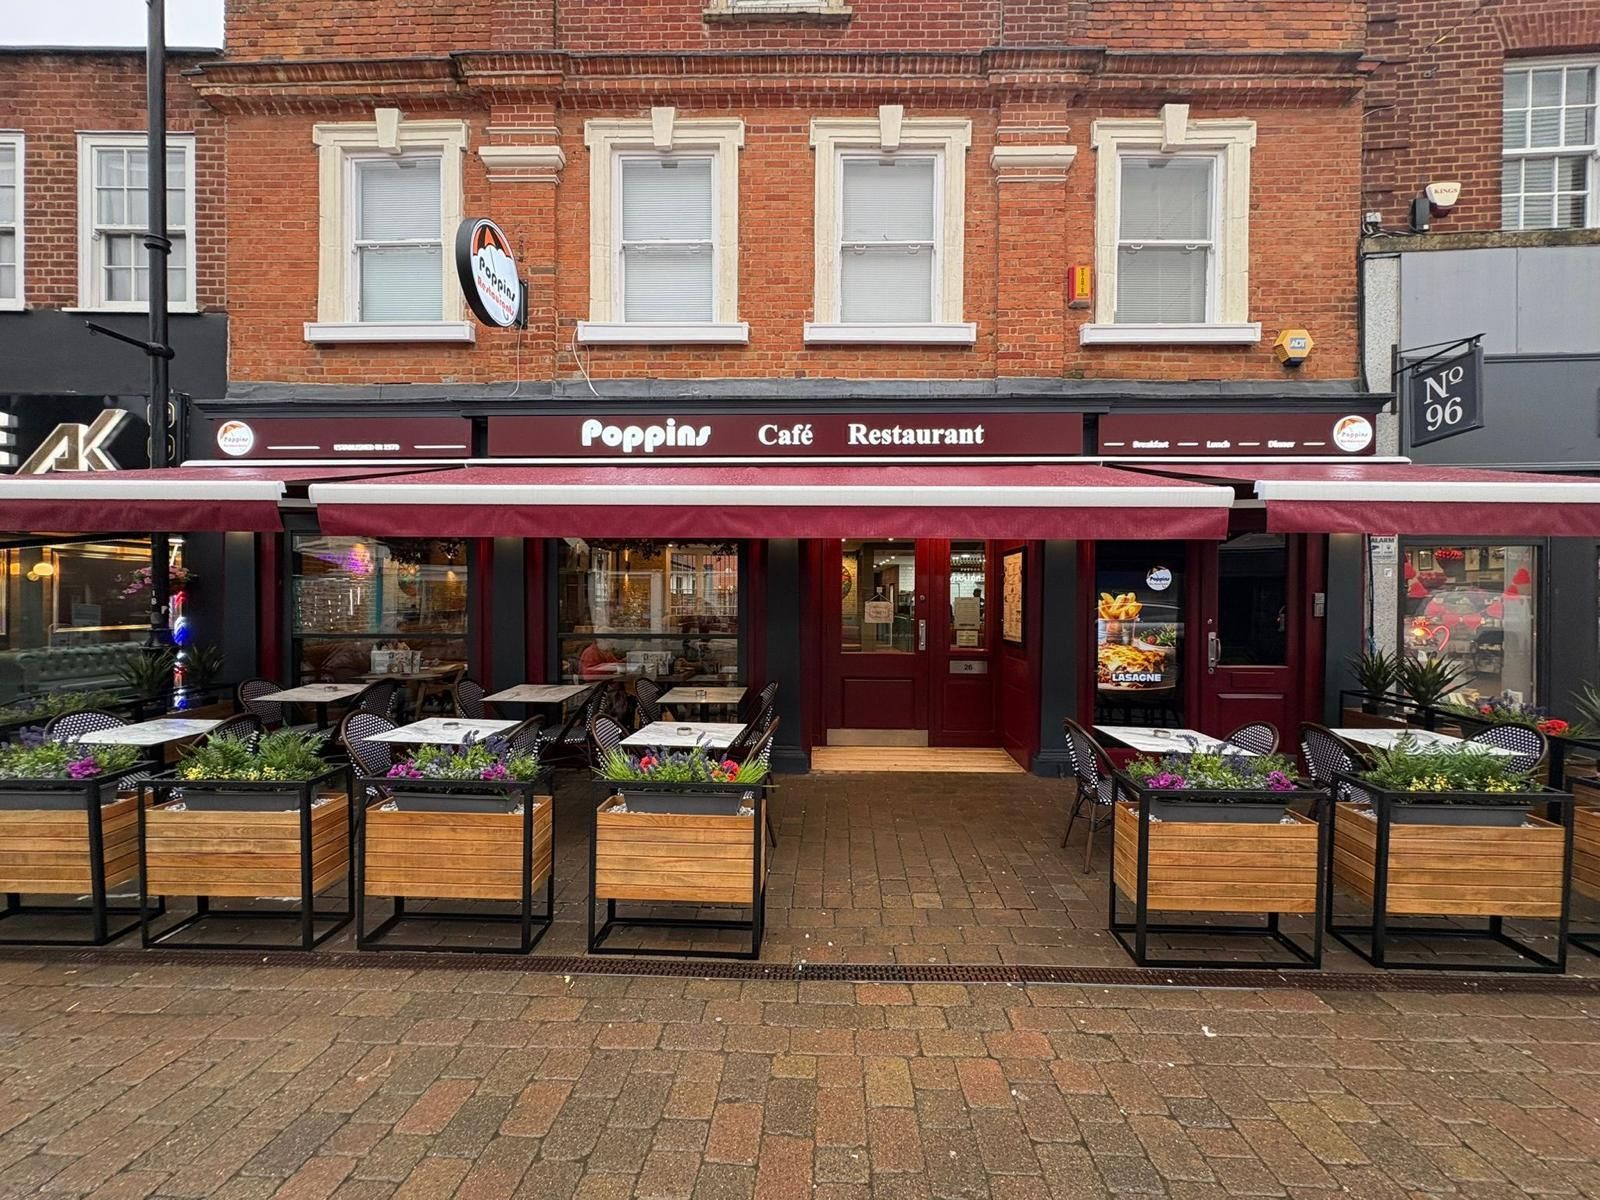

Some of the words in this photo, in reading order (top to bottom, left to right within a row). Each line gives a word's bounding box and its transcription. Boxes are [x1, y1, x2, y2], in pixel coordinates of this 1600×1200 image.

[479, 256, 516, 302] Poppins
[1426, 396, 1463, 432] 96
[581, 418, 712, 453] Poppins
[758, 424, 814, 446] Café
[848, 423, 985, 446] Restaurant
[1112, 673, 1162, 682] LASAGNE
